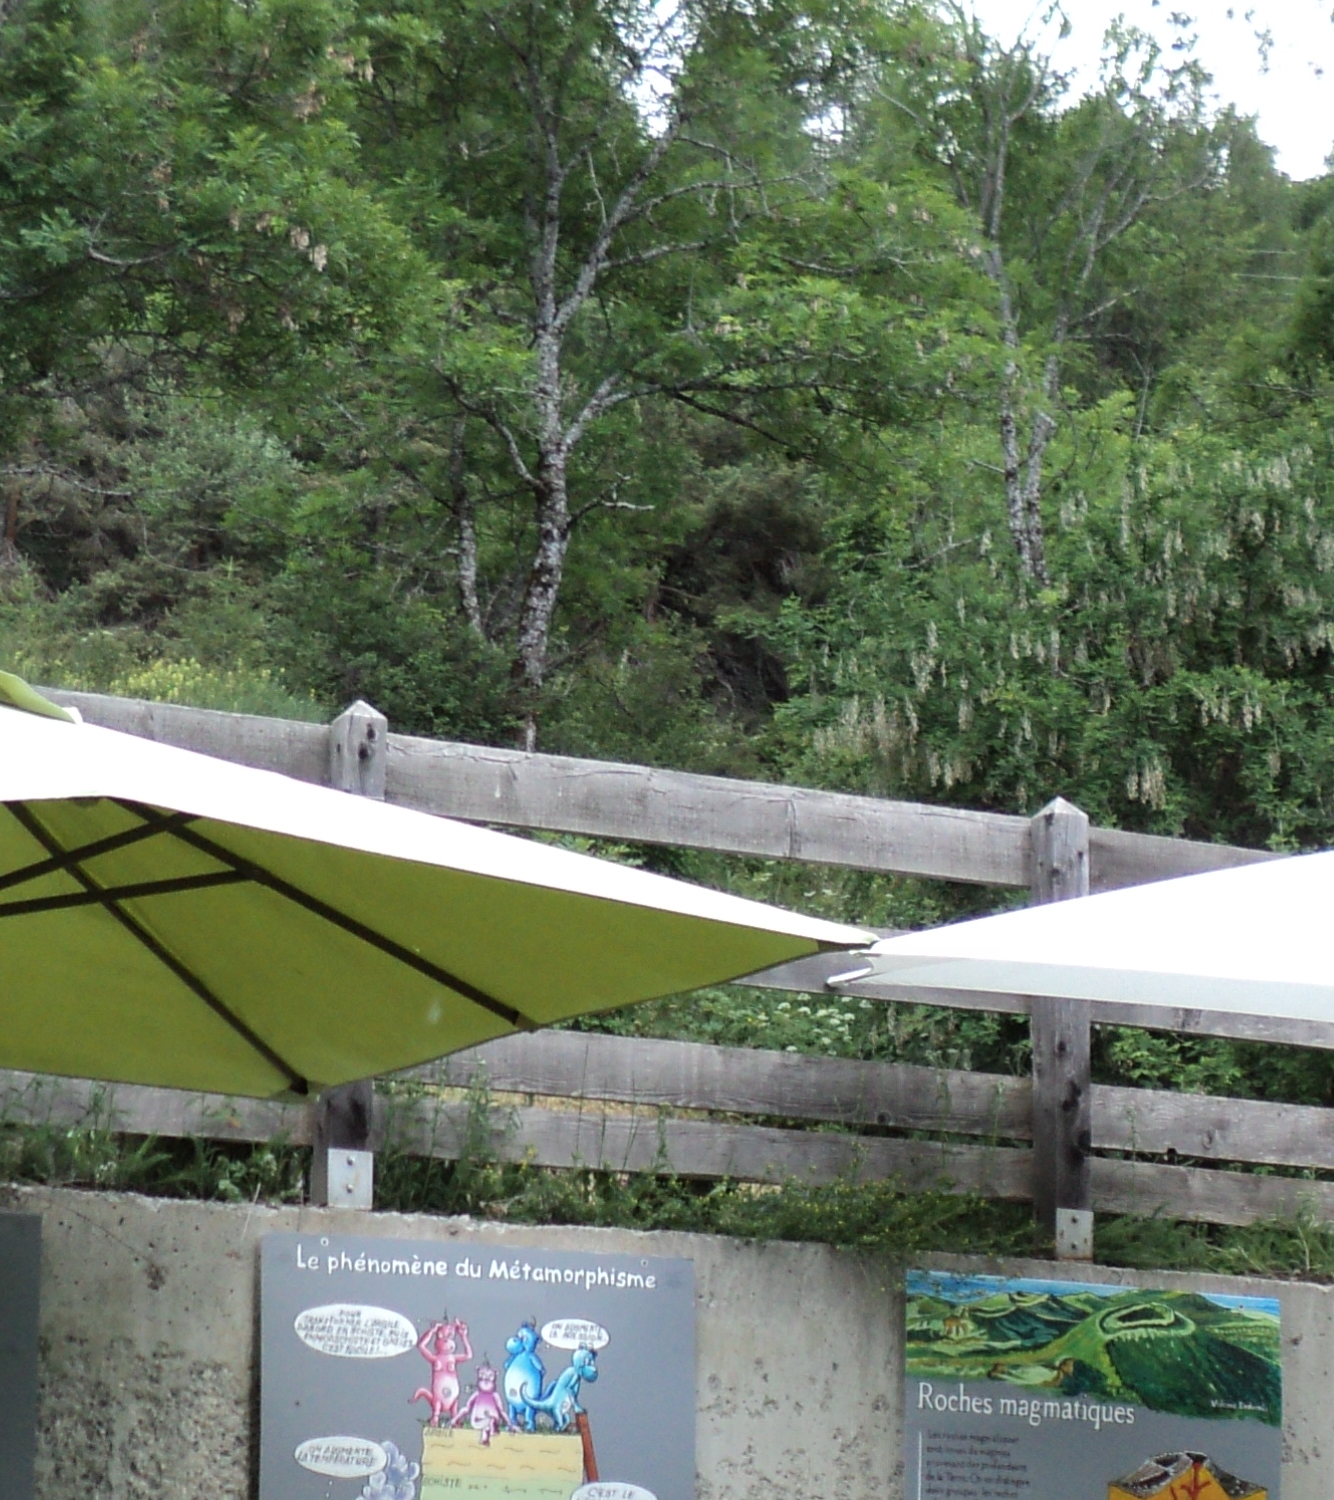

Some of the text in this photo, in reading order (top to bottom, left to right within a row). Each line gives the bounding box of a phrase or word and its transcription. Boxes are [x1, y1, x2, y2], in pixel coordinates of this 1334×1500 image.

[296, 1243, 657, 1291] Le phénomène du Métamorphisme
[917, 1382, 1136, 1431] Roches magmatiques
